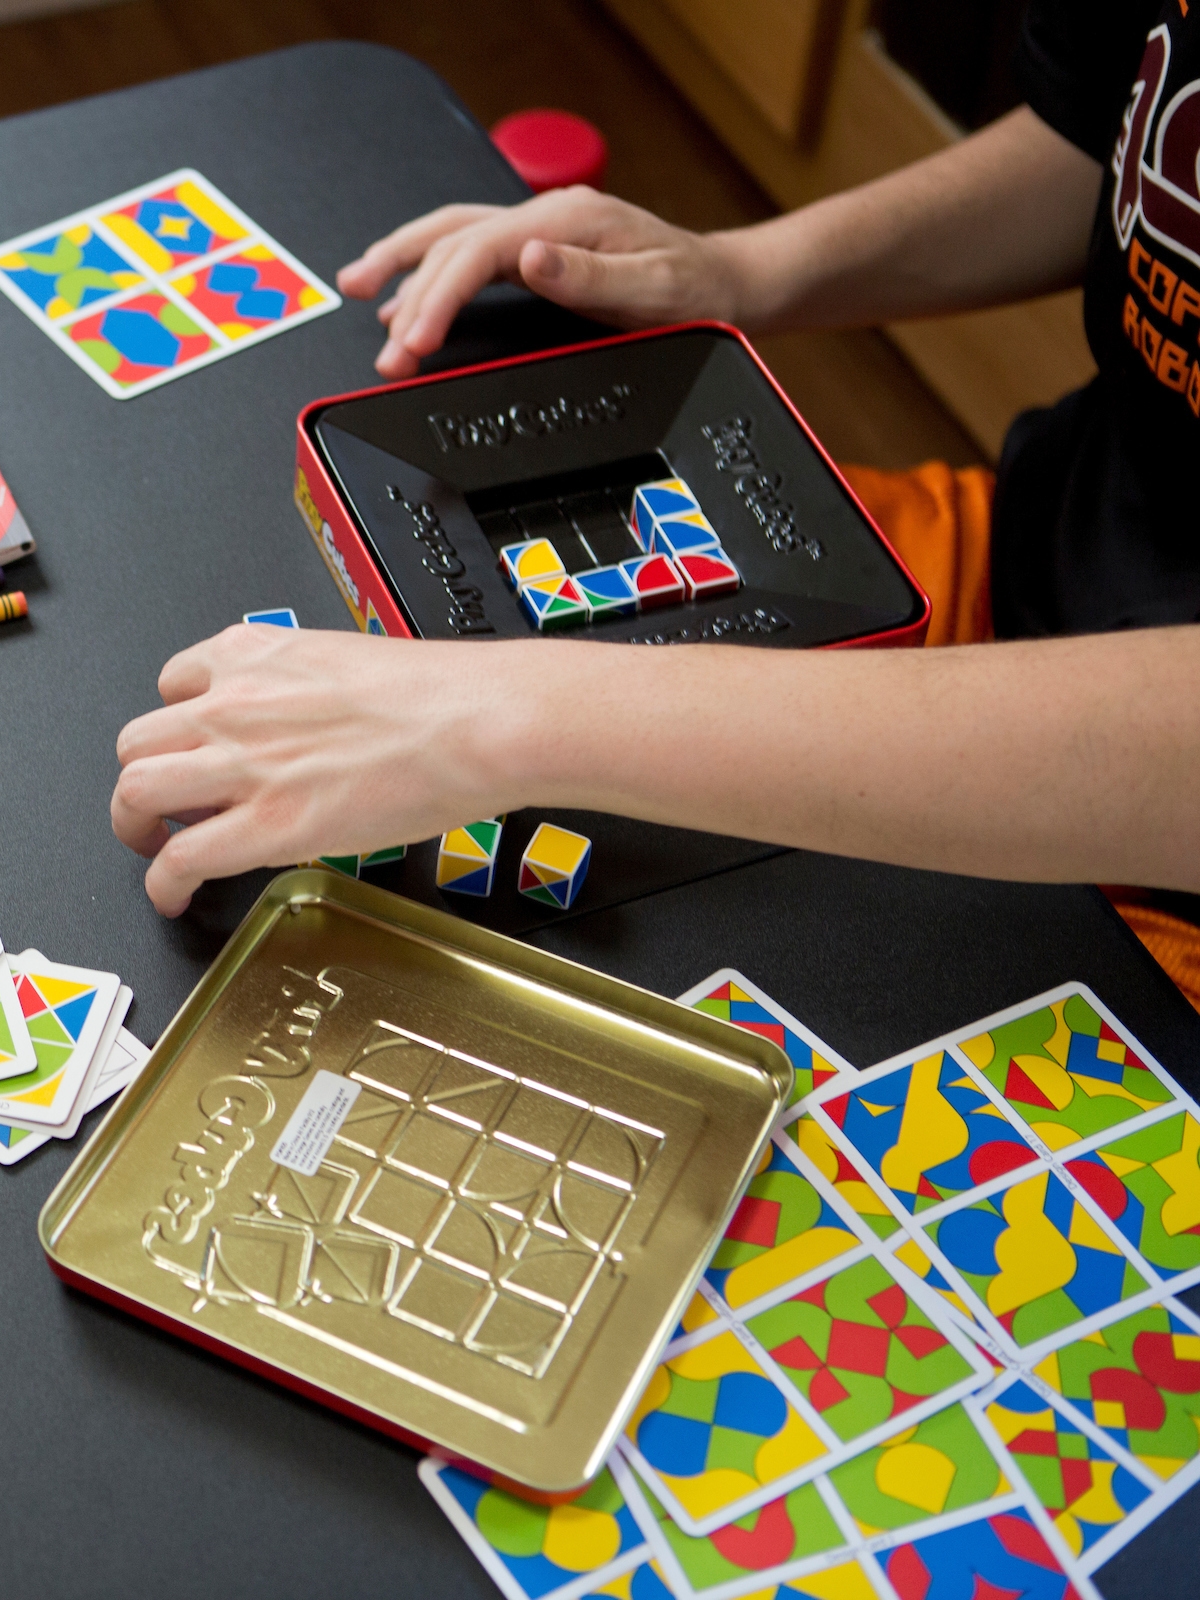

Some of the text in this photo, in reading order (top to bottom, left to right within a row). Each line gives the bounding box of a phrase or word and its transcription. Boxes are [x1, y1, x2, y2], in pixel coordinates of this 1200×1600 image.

[1025, 1134, 1077, 1190] Design Card 17
